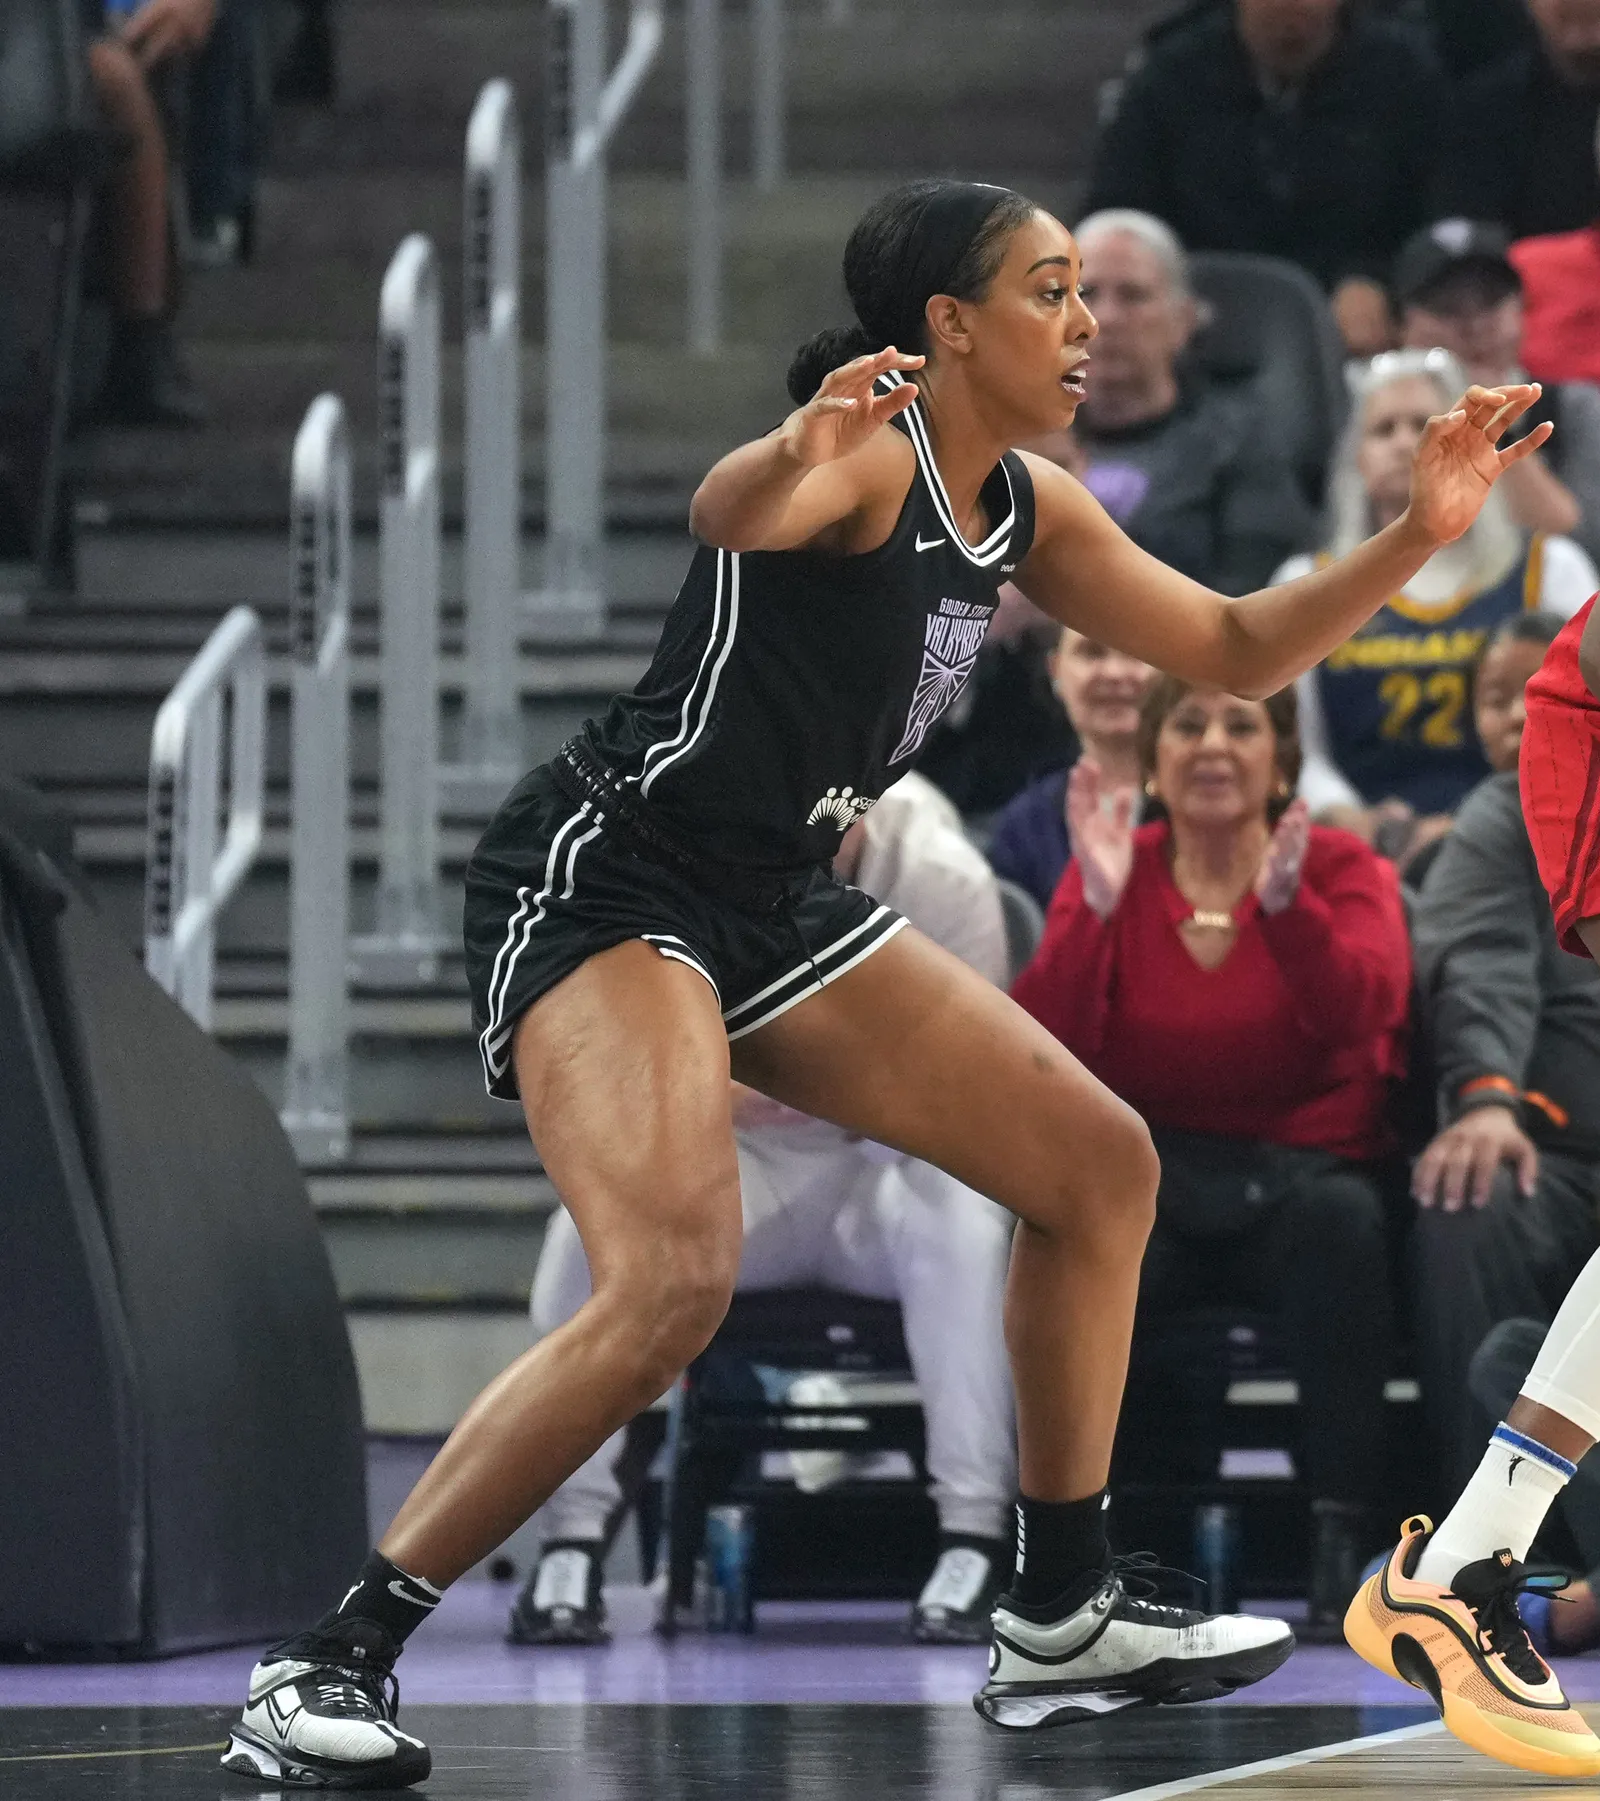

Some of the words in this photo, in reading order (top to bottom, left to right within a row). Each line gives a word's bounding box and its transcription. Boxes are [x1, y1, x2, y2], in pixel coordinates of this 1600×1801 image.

[939, 597, 972, 617] GOLDEN
[924, 613, 989, 666] VALKYRIES
[1379, 671, 1465, 747] 22
